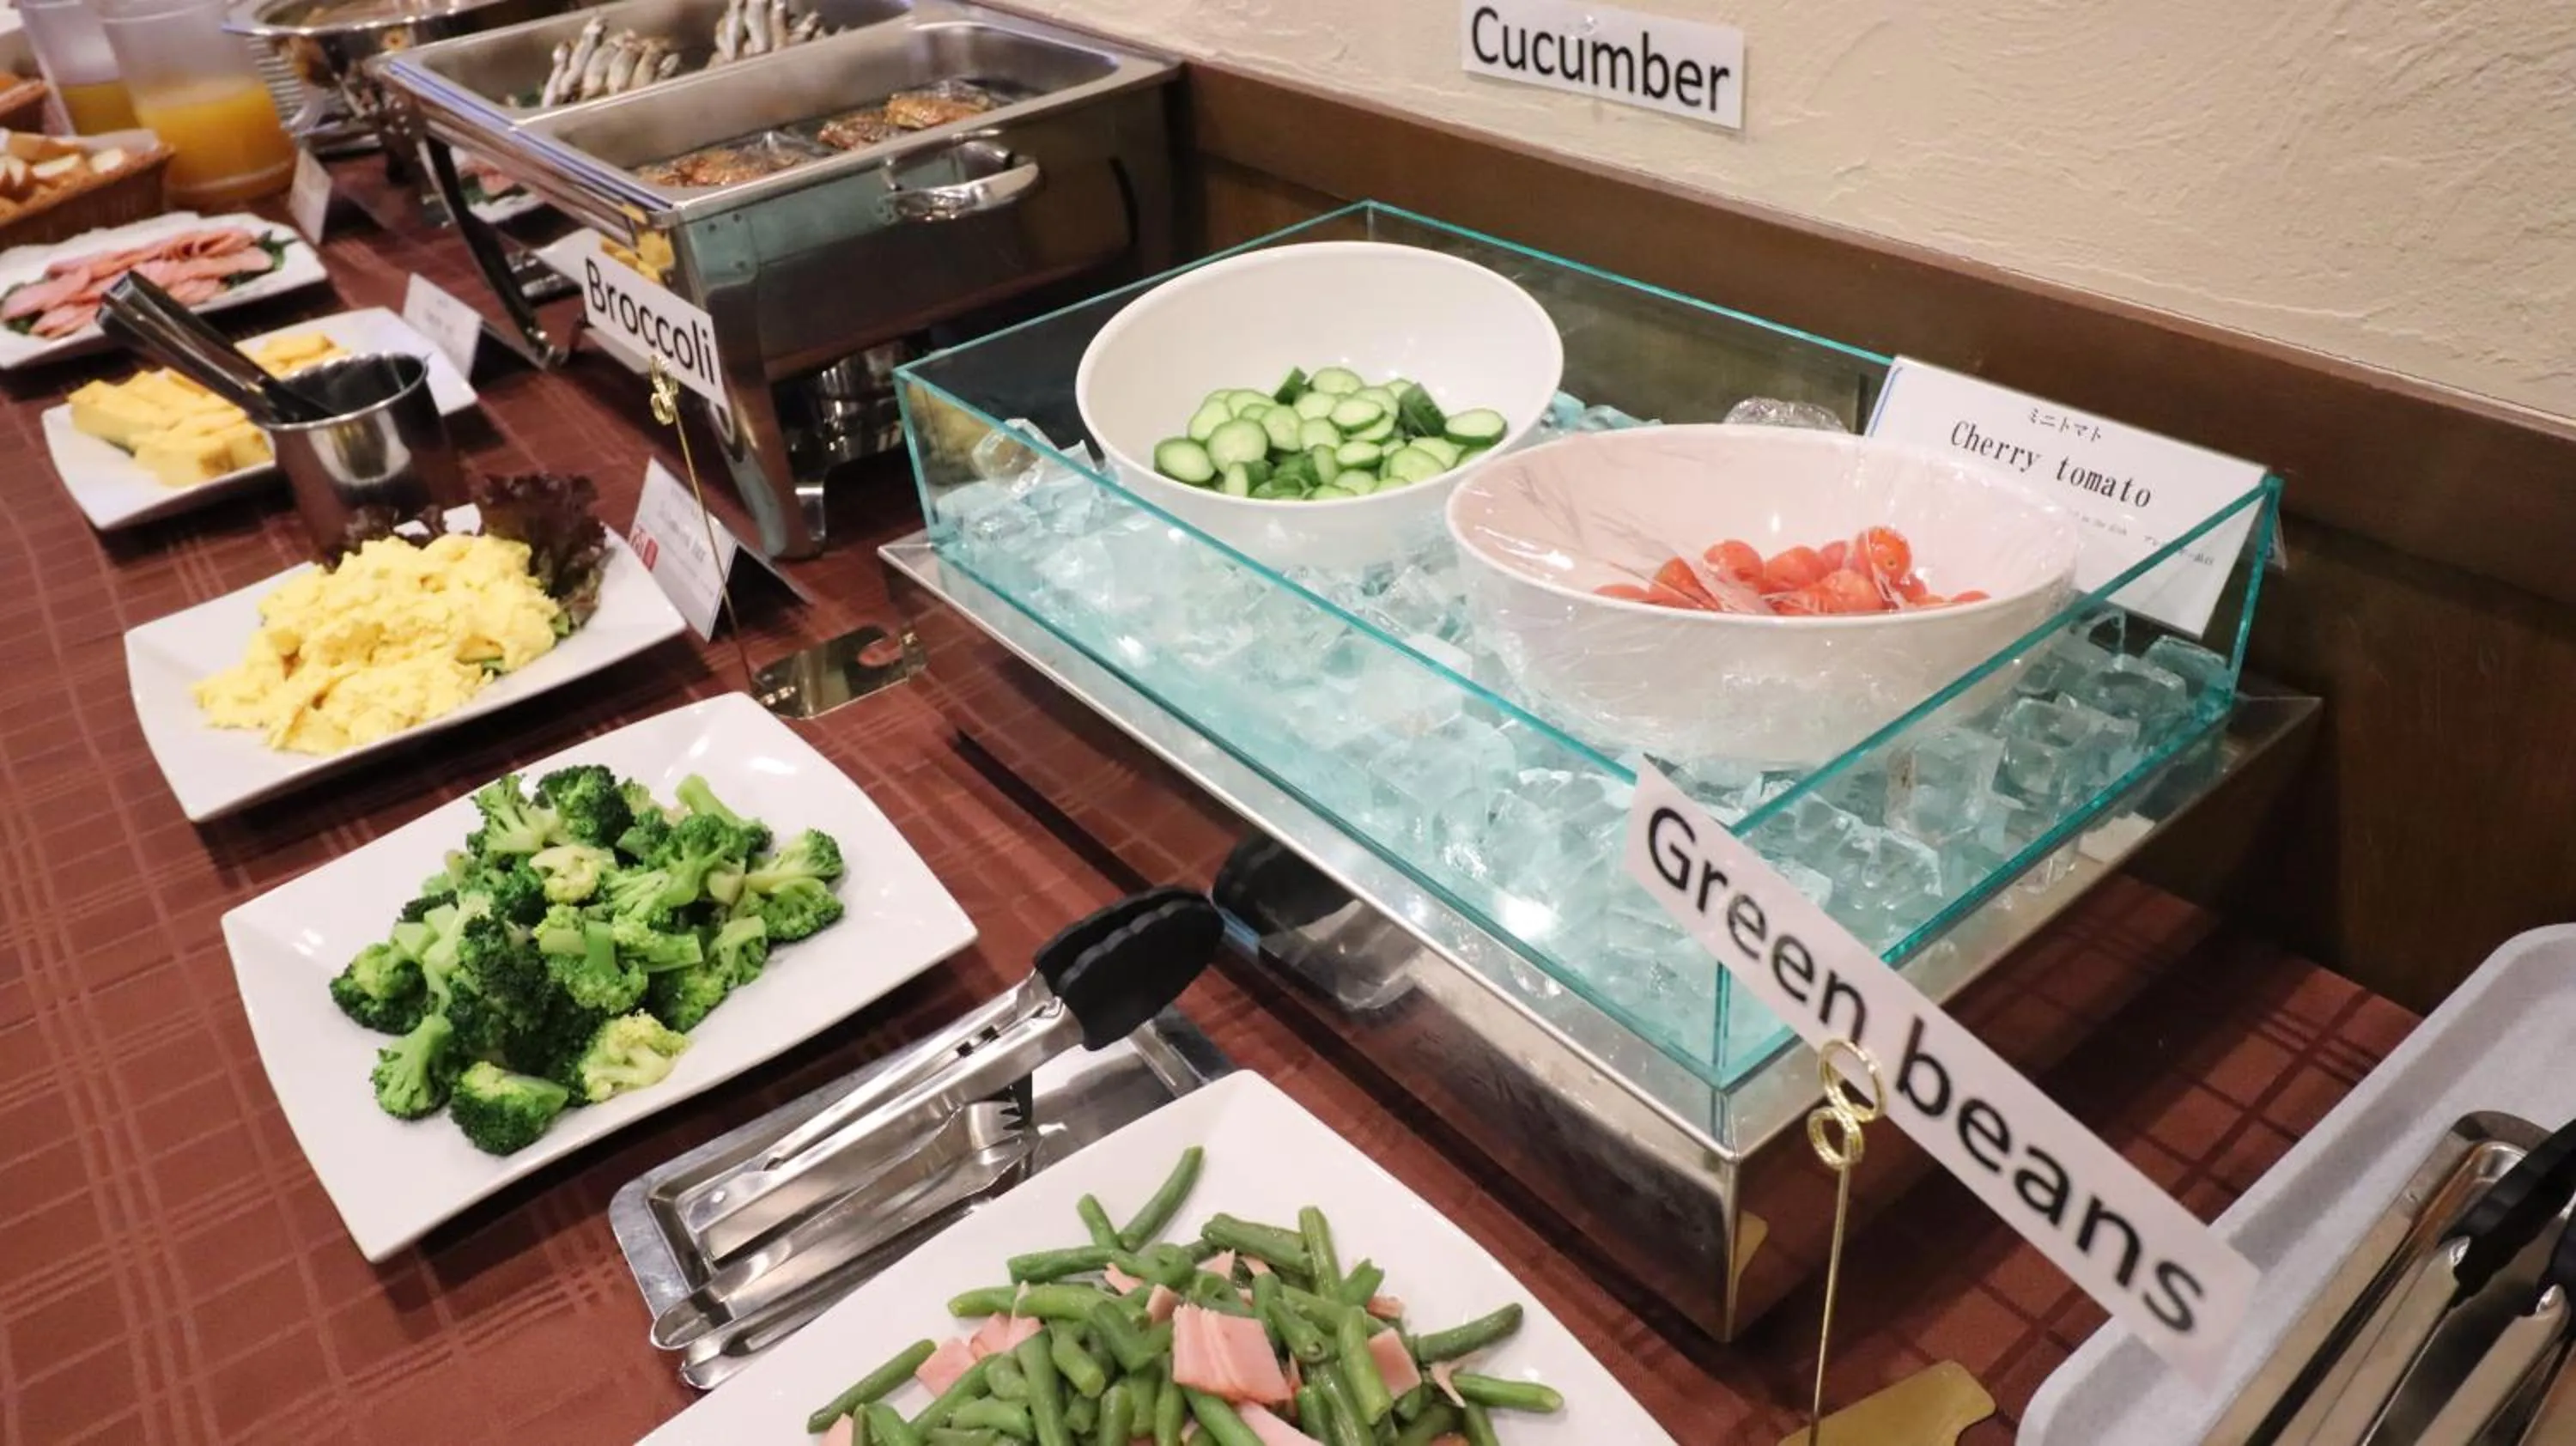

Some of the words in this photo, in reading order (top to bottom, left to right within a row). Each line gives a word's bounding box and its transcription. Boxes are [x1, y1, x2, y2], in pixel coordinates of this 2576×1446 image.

[1471, 7, 1730, 112] Cucumber
[586, 257, 715, 385] Broccoli
[1950, 420, 2041, 472] Cherry
[2057, 455, 2152, 508] tomato
[2029, 408, 2101, 442] ミニトマト
[1647, 806, 1868, 1046] Green
[1894, 1016, 2207, 1334] beans
